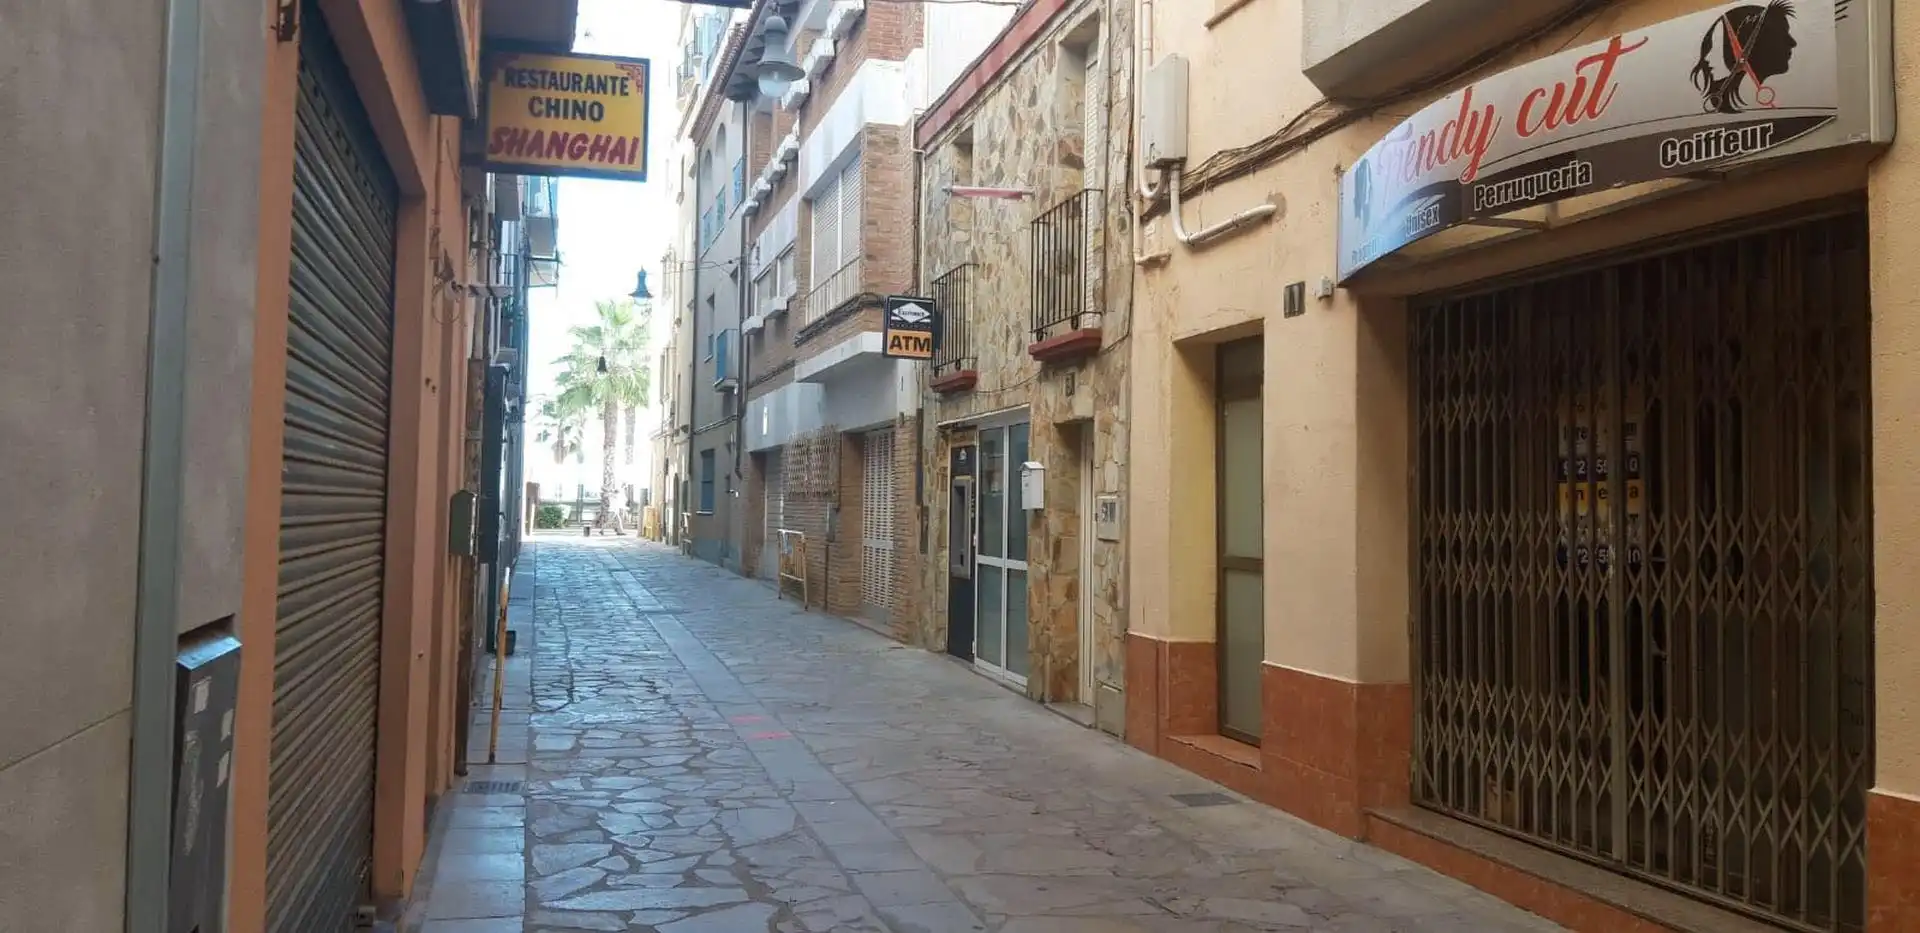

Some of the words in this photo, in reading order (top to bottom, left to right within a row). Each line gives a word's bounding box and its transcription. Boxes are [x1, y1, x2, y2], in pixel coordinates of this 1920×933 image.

[504, 66, 629, 96] RESTAURANTE
[1516, 34, 1649, 138] cut
[528, 96, 604, 122] CHINO
[487, 126, 640, 165] SHANGHAI
[1660, 122, 1773, 168] Coiffeur
[1474, 160, 1593, 212] Perruqueria
[1405, 204, 1440, 237] Unisex
[889, 334, 931, 352] ATM
